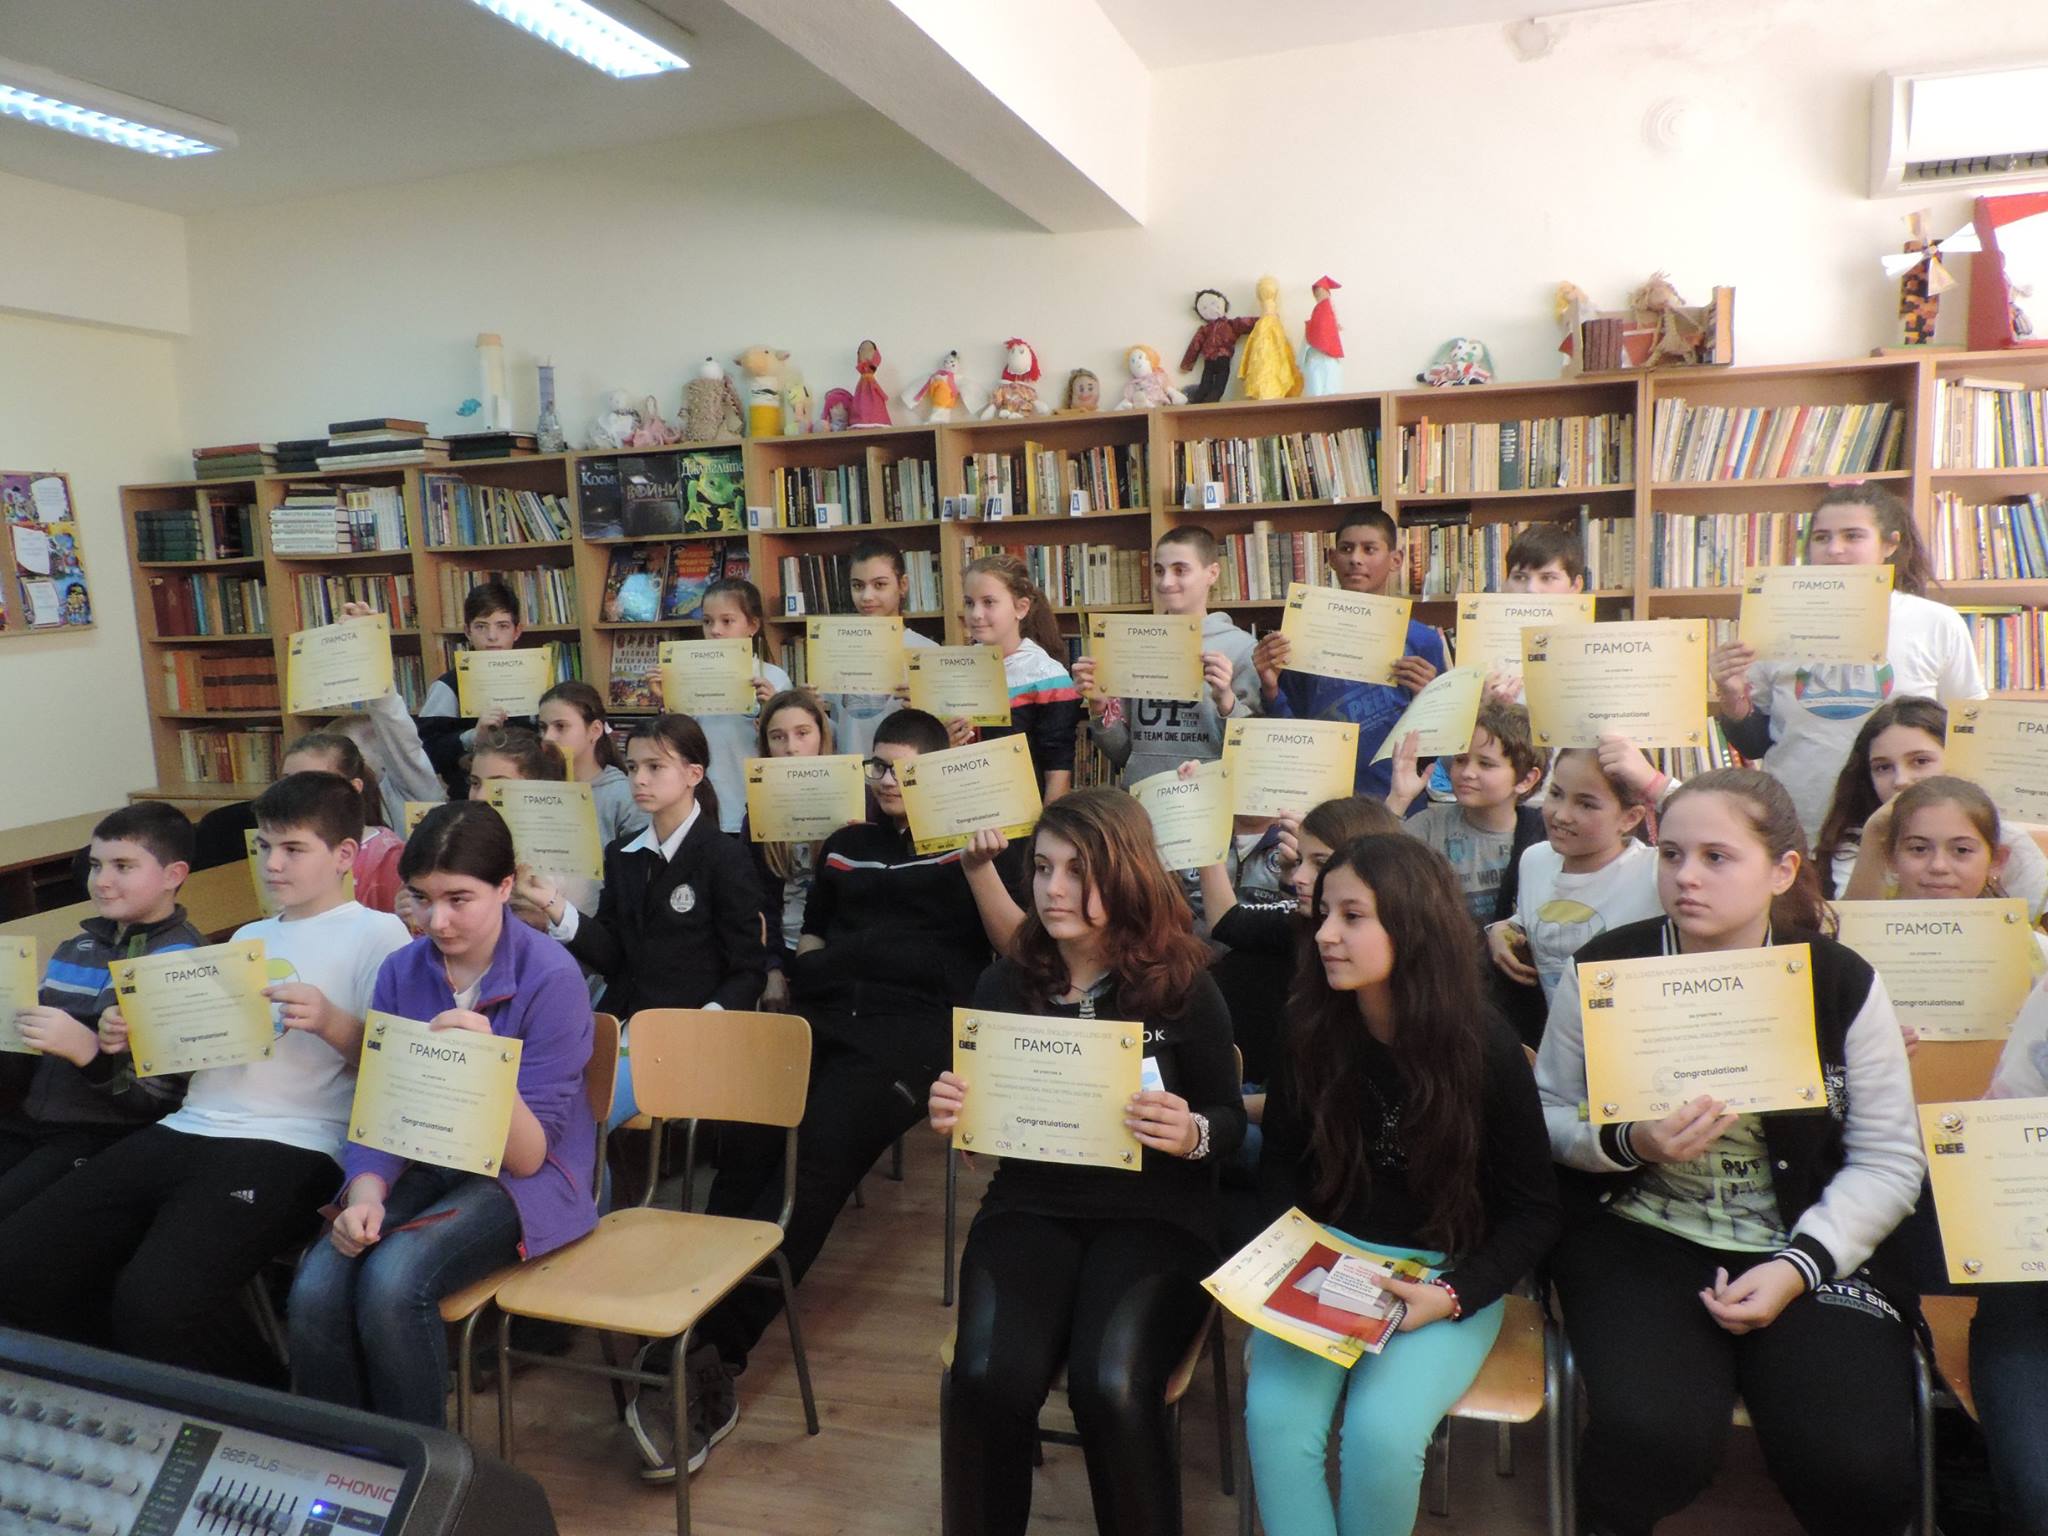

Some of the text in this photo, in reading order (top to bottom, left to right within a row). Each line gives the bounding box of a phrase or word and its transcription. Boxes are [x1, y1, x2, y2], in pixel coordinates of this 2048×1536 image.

[1328, 602, 1372, 616] ГРАМОТА
[1505, 607, 1553, 617] ГРАМОТА
[1584, 641, 1652, 655] ГРАМОТА
[1144, 732, 1162, 742] TEAM
[1181, 732, 1209, 743] DREAM
[1267, 734, 1314, 745] ГРАМОТА
[942, 759, 990, 776] ГРАМОТА
[1886, 922, 1963, 935] ГРАМОТА
[164, 965, 220, 983] ГРАМОТА
[1662, 976, 1744, 997] ГРАМОТА
[1588, 998, 1615, 1010] BEE
[959, 1040, 976, 1050] BEE
[1014, 1038, 1082, 1056] ГРАМОТА
[409, 1042, 467, 1064] ГРАМОТА
[1673, 1064, 1748, 1080] Congratulations!
[1016, 1116, 1080, 1130] Congratulations!
[1935, 1142, 1965, 1155] BEE
[244, 1453, 280, 1472] PLUS
[325, 1472, 398, 1504] PHONIC
